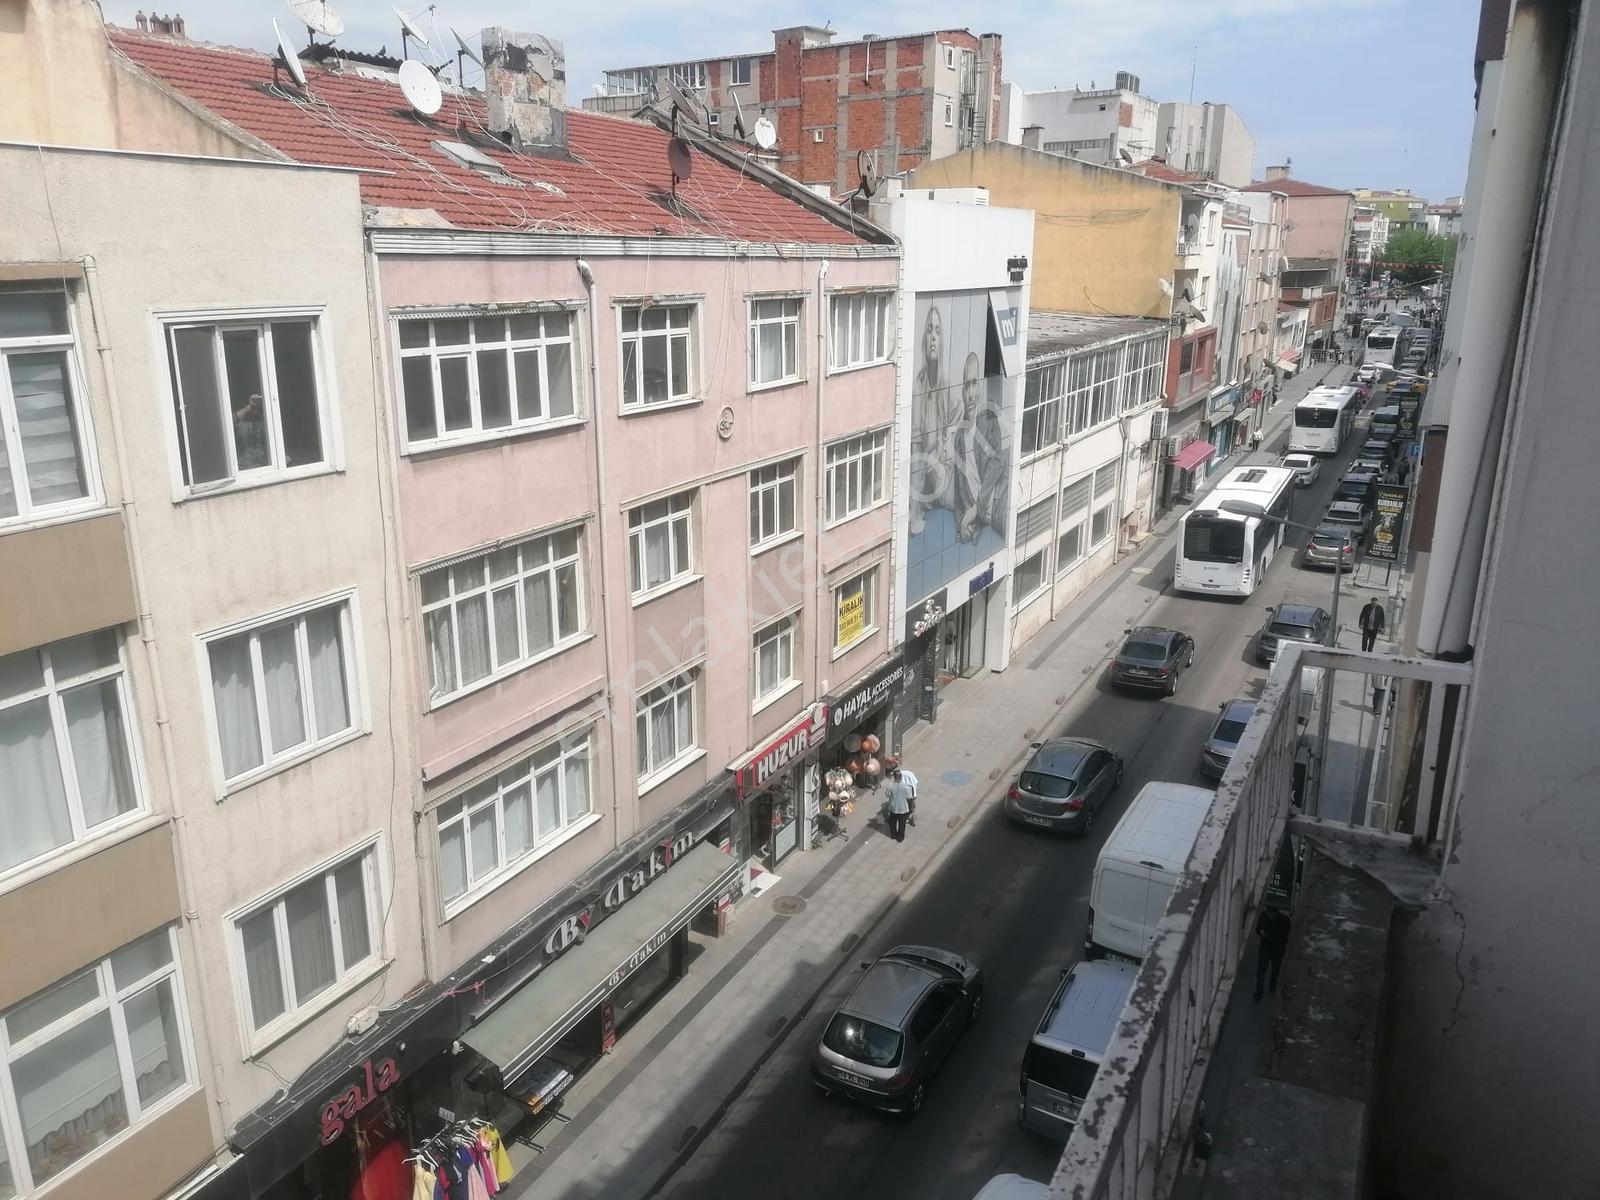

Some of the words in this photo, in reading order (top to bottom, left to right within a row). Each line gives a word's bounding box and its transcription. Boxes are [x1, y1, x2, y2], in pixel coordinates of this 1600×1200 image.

[843, 687, 871, 720] HAYAL
[757, 729, 808, 784] HUZUR
[320, 1057, 400, 1146] gala
